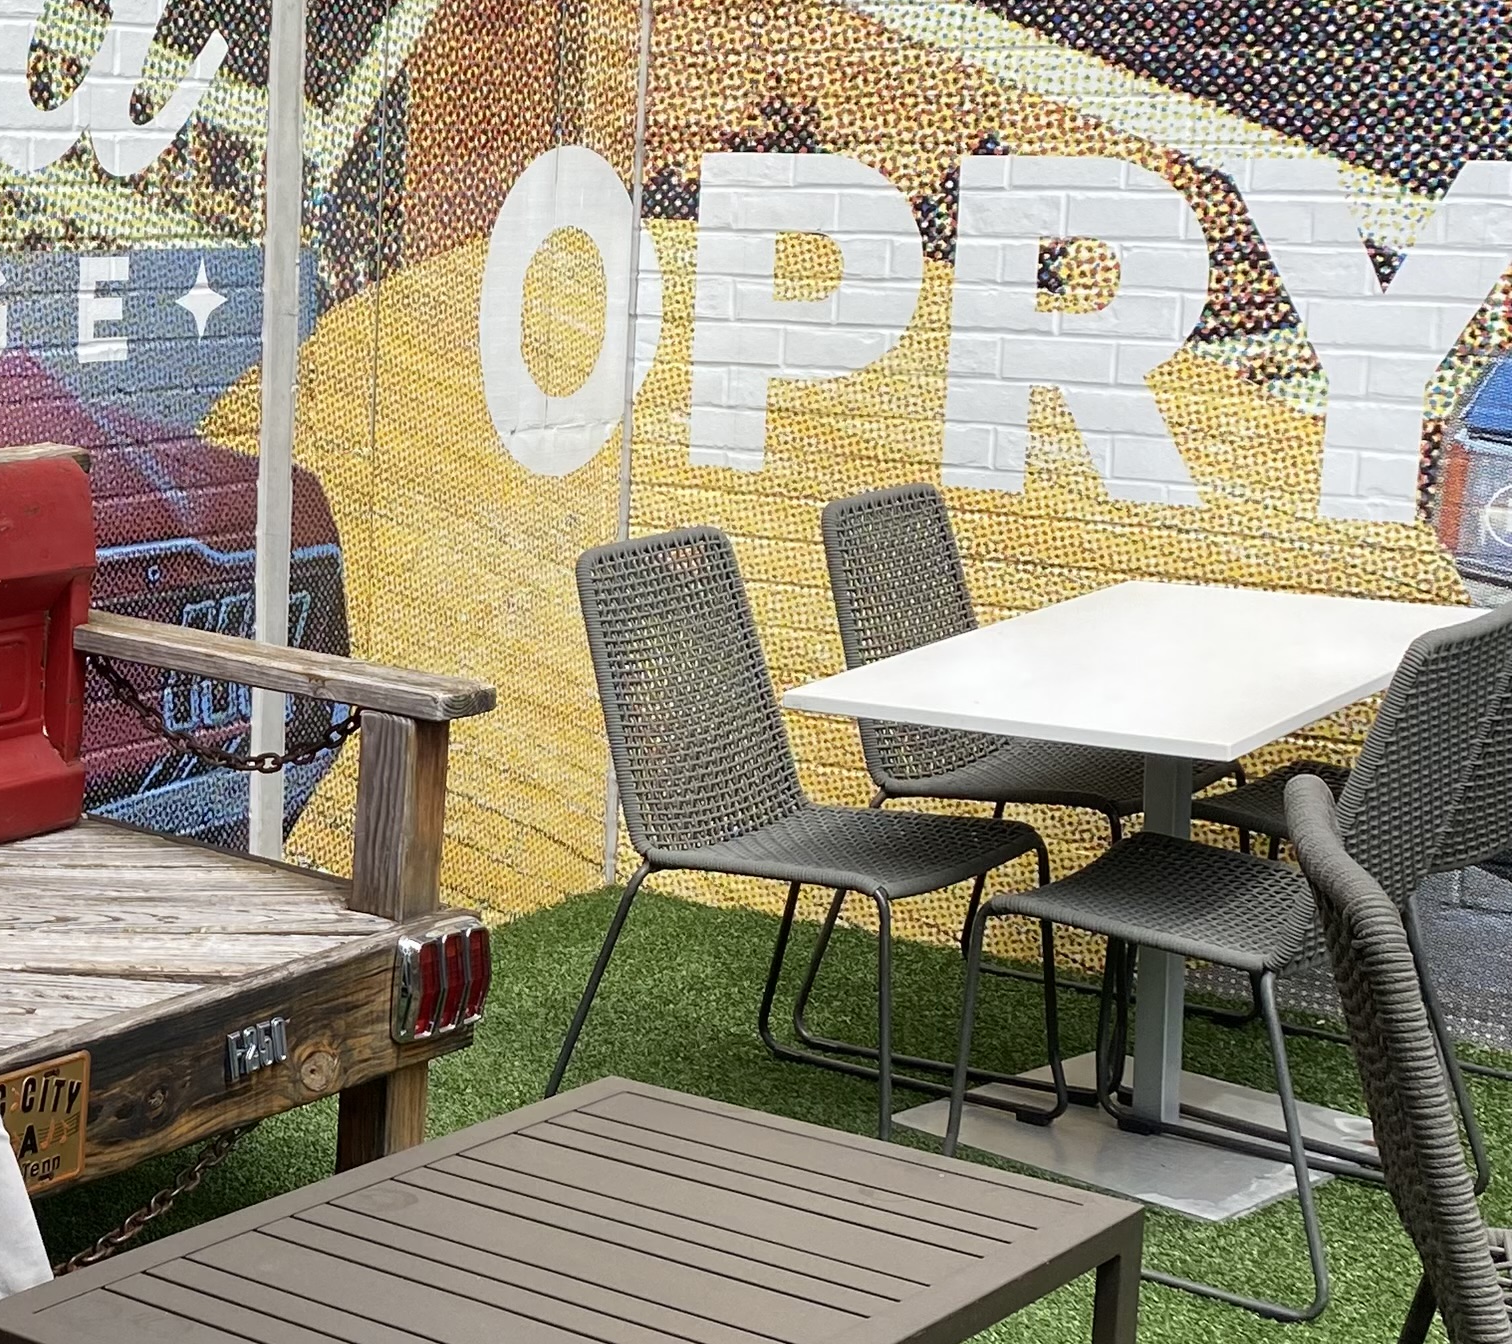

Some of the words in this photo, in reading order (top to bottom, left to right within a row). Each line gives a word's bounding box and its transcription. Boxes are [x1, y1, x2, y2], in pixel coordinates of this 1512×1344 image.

[479, 144, 1512, 523] OPRY
[20, 1075, 82, 1114] CITY
[22, 1154, 61, 1179] Tenn
